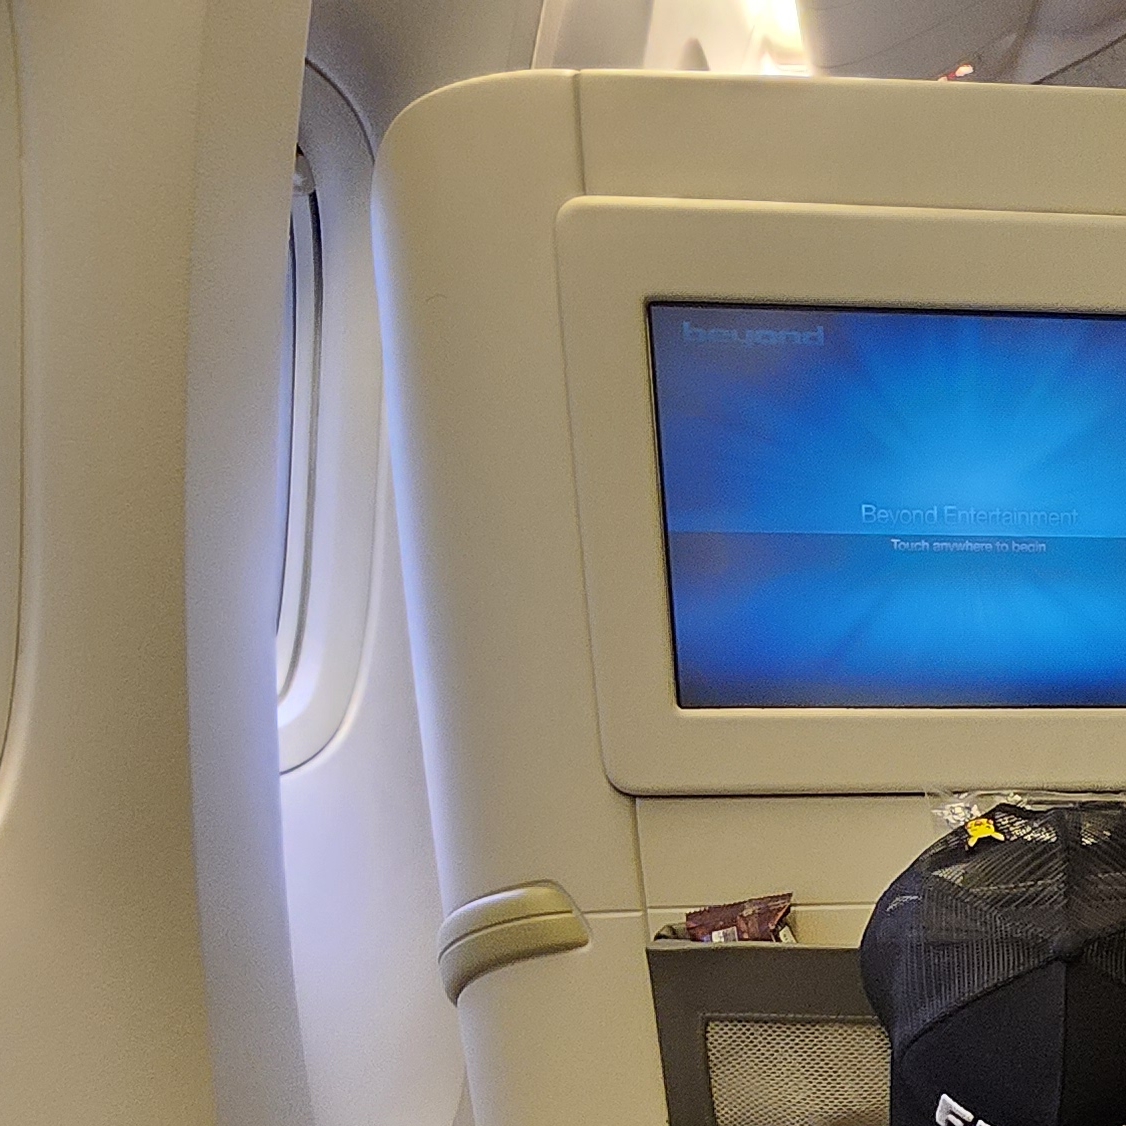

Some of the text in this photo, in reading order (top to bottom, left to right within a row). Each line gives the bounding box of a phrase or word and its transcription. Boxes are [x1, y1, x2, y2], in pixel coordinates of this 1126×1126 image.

[683, 321, 824, 348] beyond
[861, 504, 1078, 526] Beyond Entertainment
[891, 538, 1046, 553] Touch anywhere to begin
